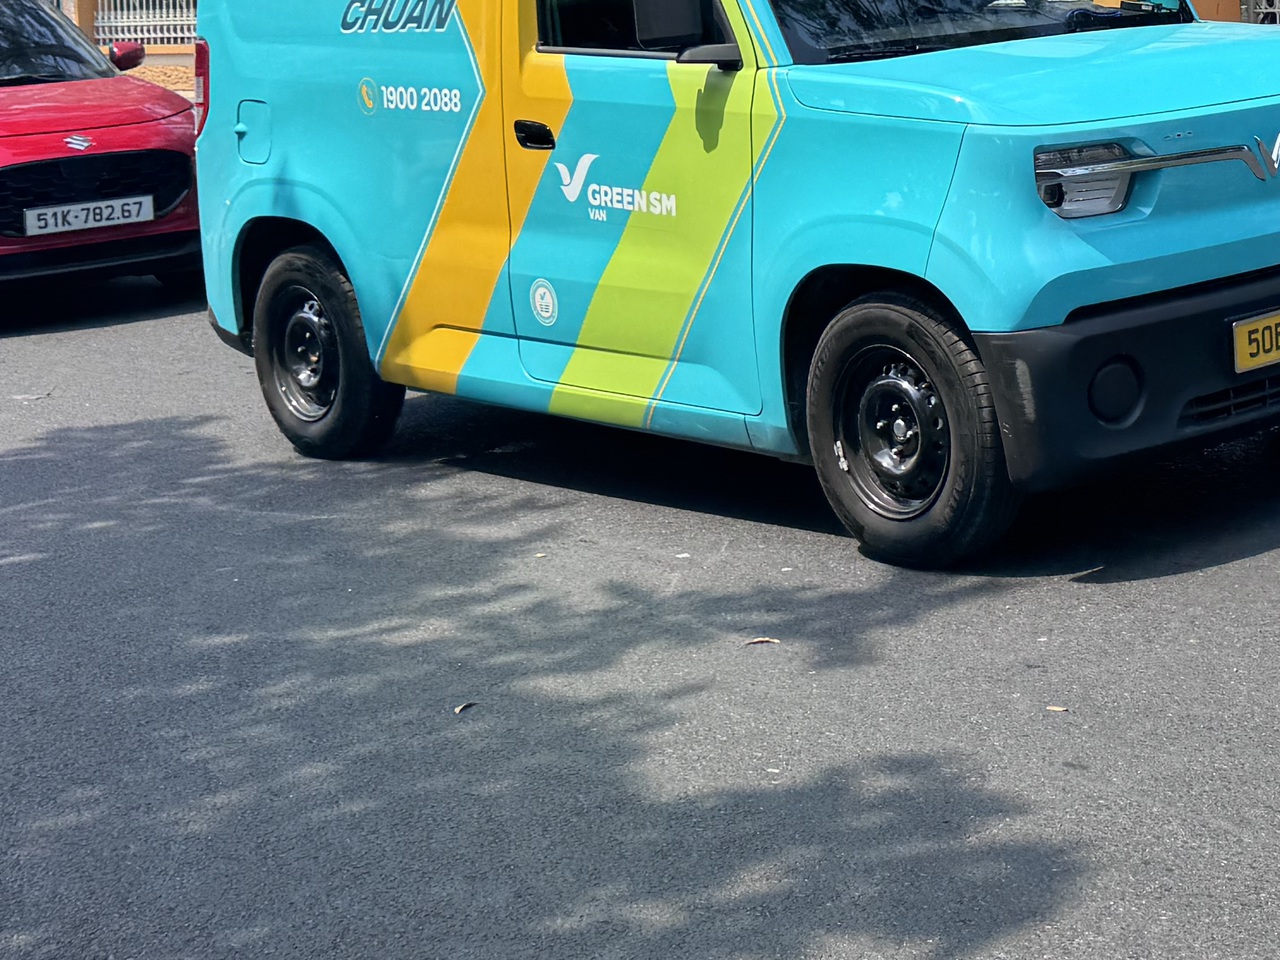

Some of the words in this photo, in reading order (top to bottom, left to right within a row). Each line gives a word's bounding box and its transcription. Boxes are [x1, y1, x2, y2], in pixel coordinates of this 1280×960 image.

[381, 85, 418, 109] 1900
[421, 88, 461, 112] 2088
[587, 183, 647, 213] GREEN
[649, 191, 677, 216] SM
[588, 207, 607, 221] VAN
